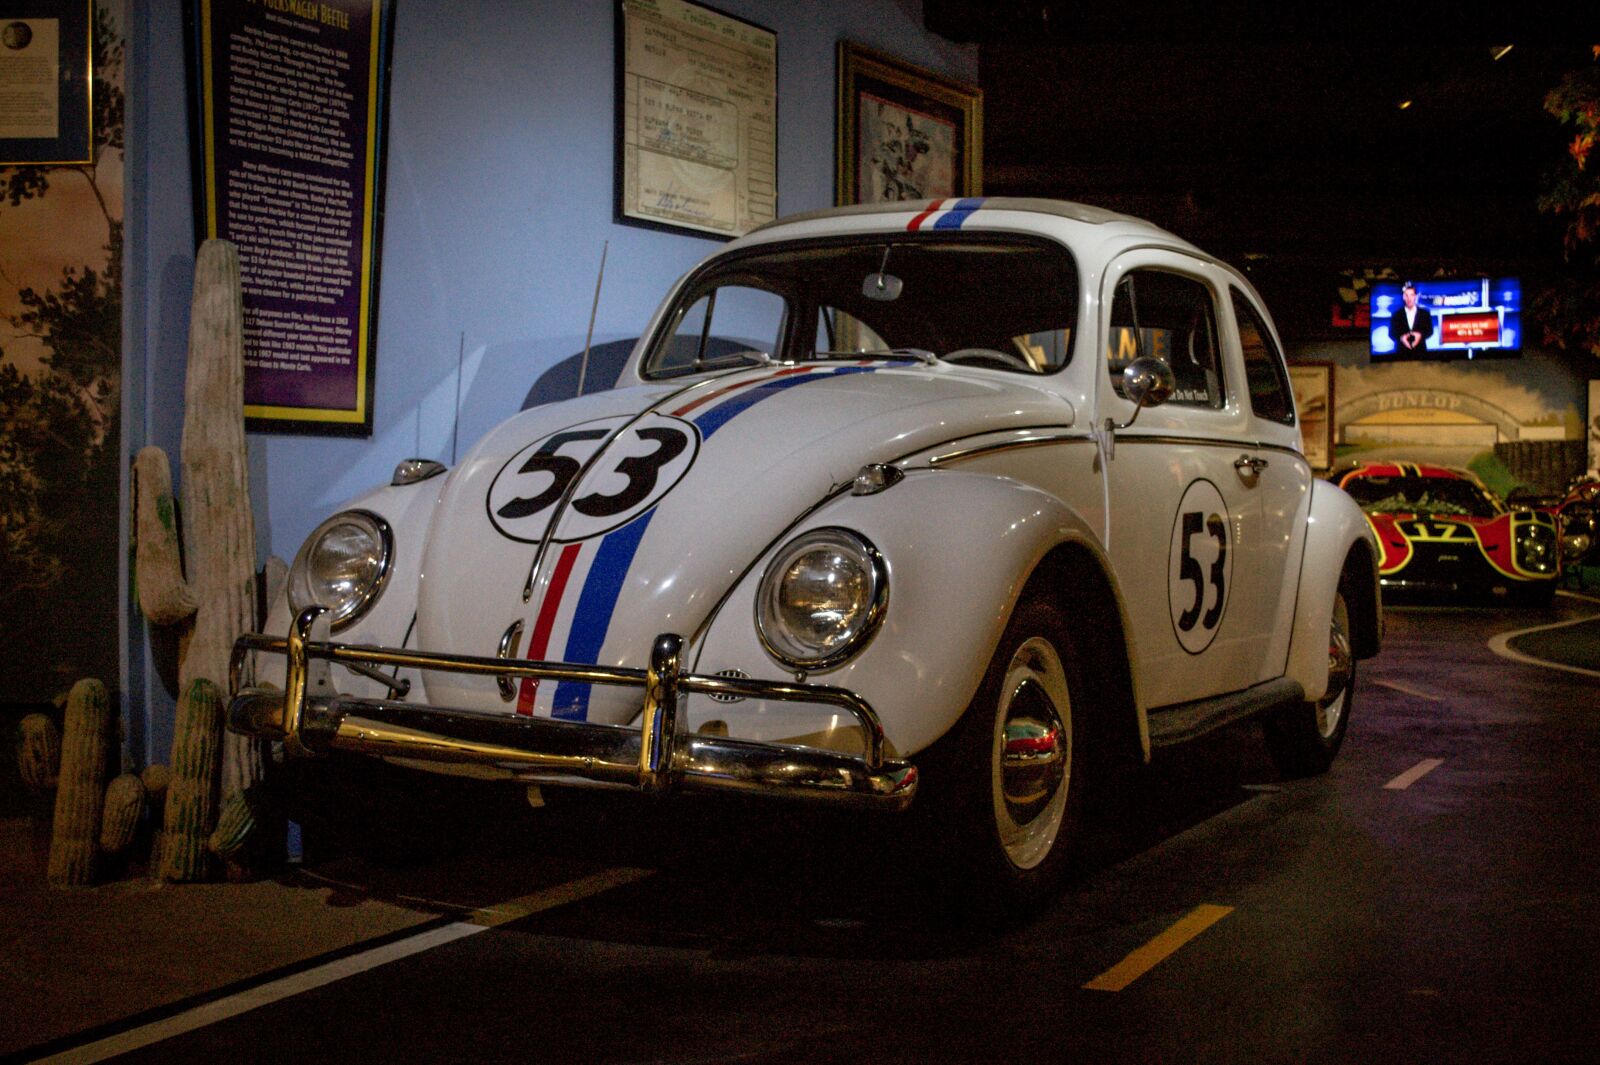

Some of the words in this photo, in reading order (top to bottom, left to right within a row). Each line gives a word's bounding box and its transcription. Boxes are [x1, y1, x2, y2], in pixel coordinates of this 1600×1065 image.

[320, 4, 349, 30] BEETLE
[1379, 390, 1461, 411] DUNLOP
[496, 427, 688, 519] 53
[1413, 523, 1457, 541] 17
[1178, 511, 1227, 632] 53
